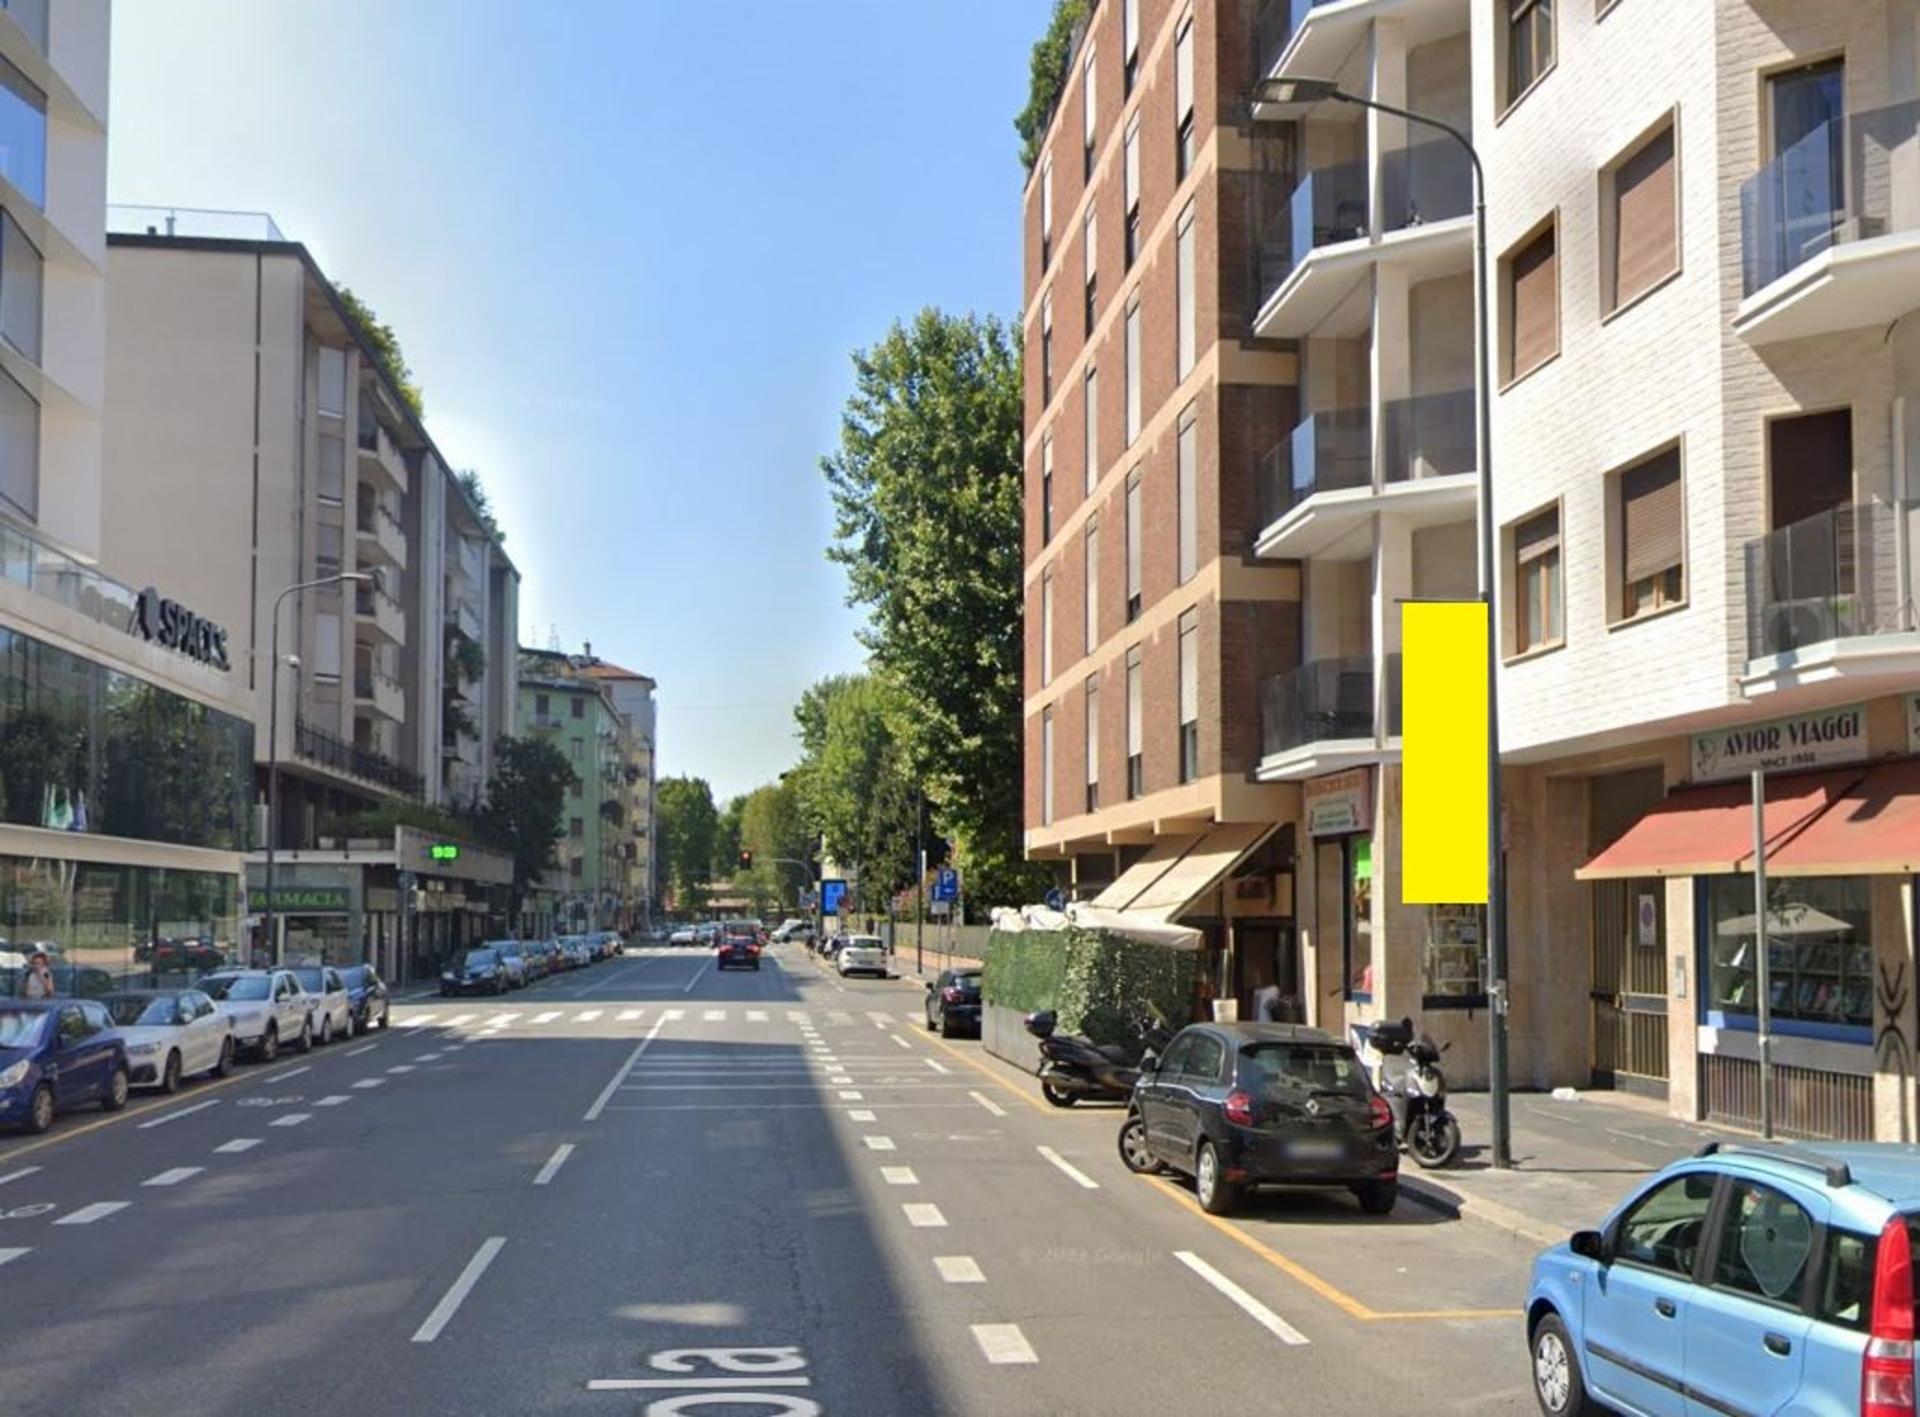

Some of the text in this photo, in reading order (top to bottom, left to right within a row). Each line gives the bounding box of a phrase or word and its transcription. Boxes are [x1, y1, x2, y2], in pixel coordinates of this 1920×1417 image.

[1723, 712, 1860, 757] AVIOR VIAGGI
[943, 870, 955, 885] P
